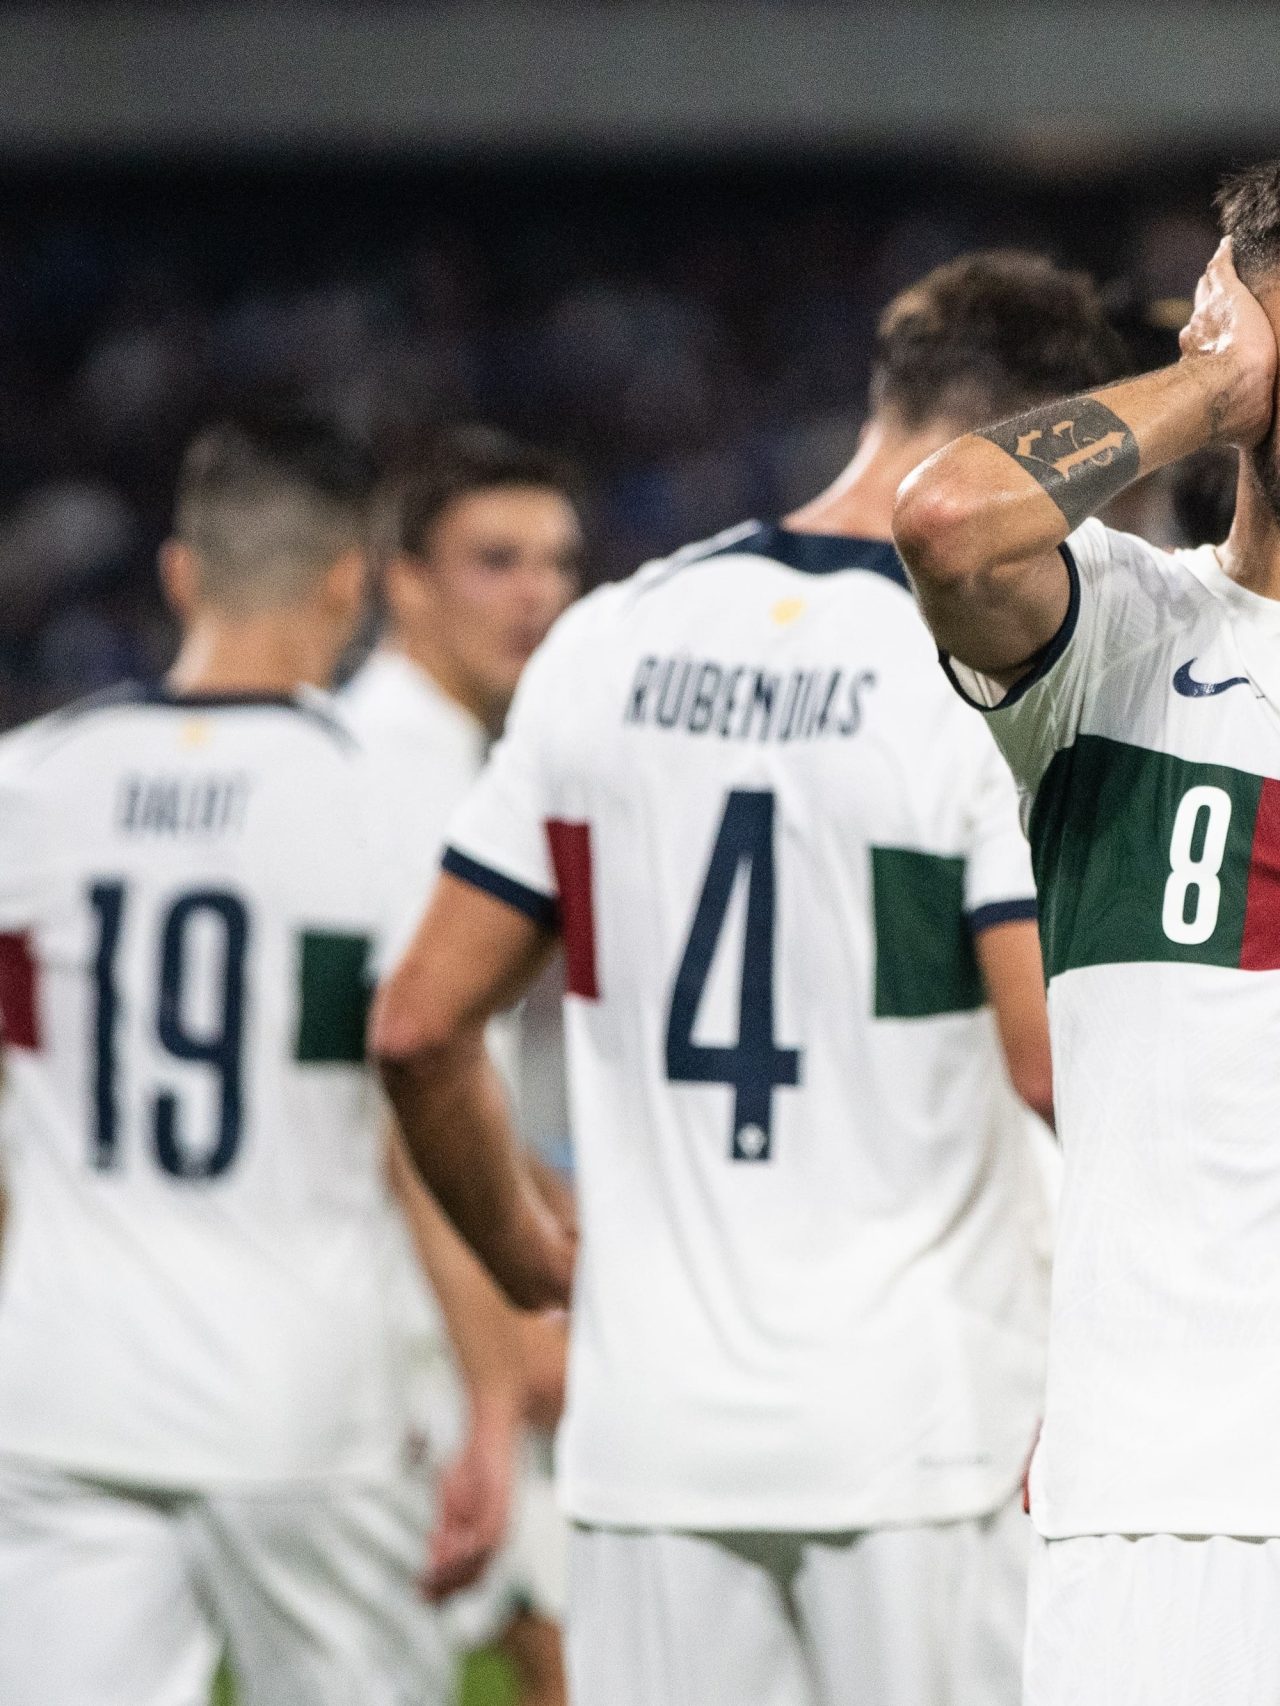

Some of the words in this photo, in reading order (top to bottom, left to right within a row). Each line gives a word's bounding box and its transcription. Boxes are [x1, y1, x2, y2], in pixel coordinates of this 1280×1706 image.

[666, 789, 799, 1160] 4
[1162, 785, 1232, 945] 8
[88, 876, 250, 1180] 19
